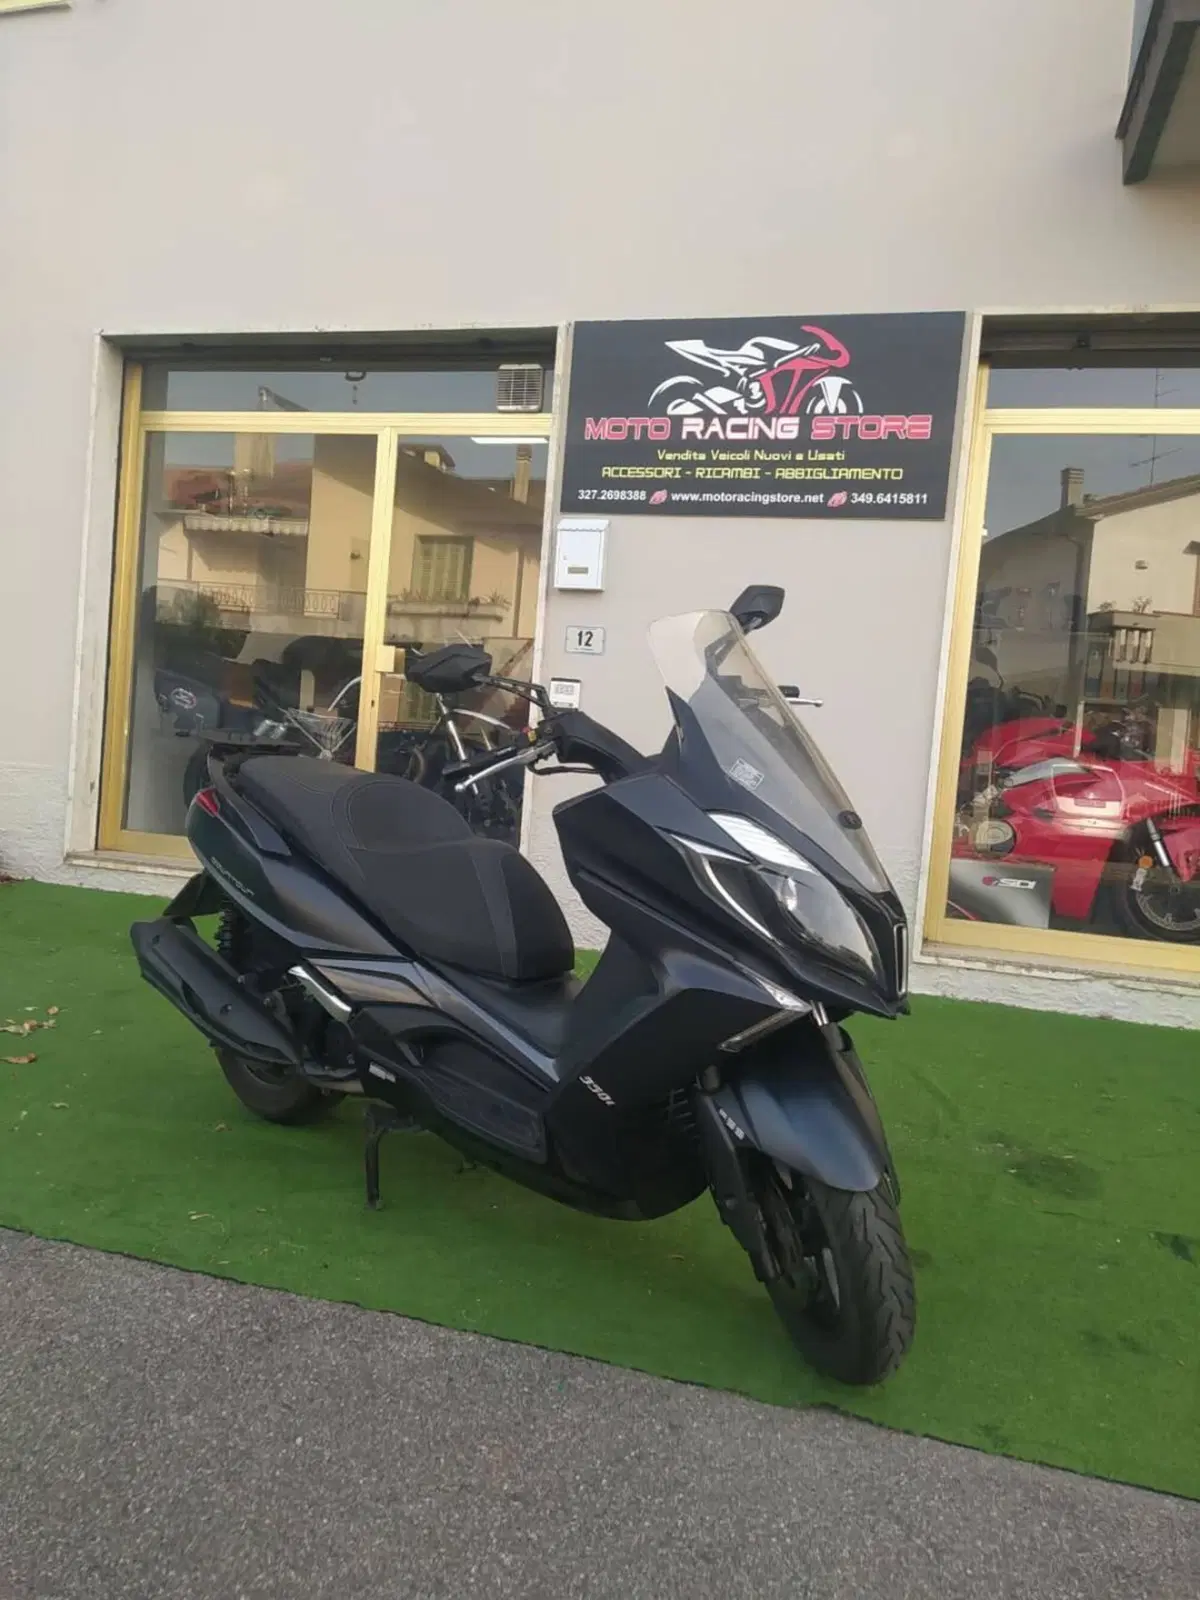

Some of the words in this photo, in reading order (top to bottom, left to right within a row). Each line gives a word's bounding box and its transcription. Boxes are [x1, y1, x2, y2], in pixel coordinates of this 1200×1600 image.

[584, 416, 671, 440] MOTO
[681, 416, 800, 440] RACING
[810, 414, 933, 440] STORE
[657, 449, 706, 461] Vendita
[711, 449, 750, 461] Veicoli
[754, 450, 792, 461] Nuovi
[807, 450, 845, 461] Usati
[601, 466, 682, 479] ACCESSORI
[695, 467, 761, 479] RICAMBI
[775, 467, 903, 480] ABBIGLIAMENTO
[577, 489, 647, 501] 327.2698388
[671, 491, 824, 505] www.motoracingstore.net
[851, 492, 928, 505] 349.6415811
[577, 630, 594, 647] 12
